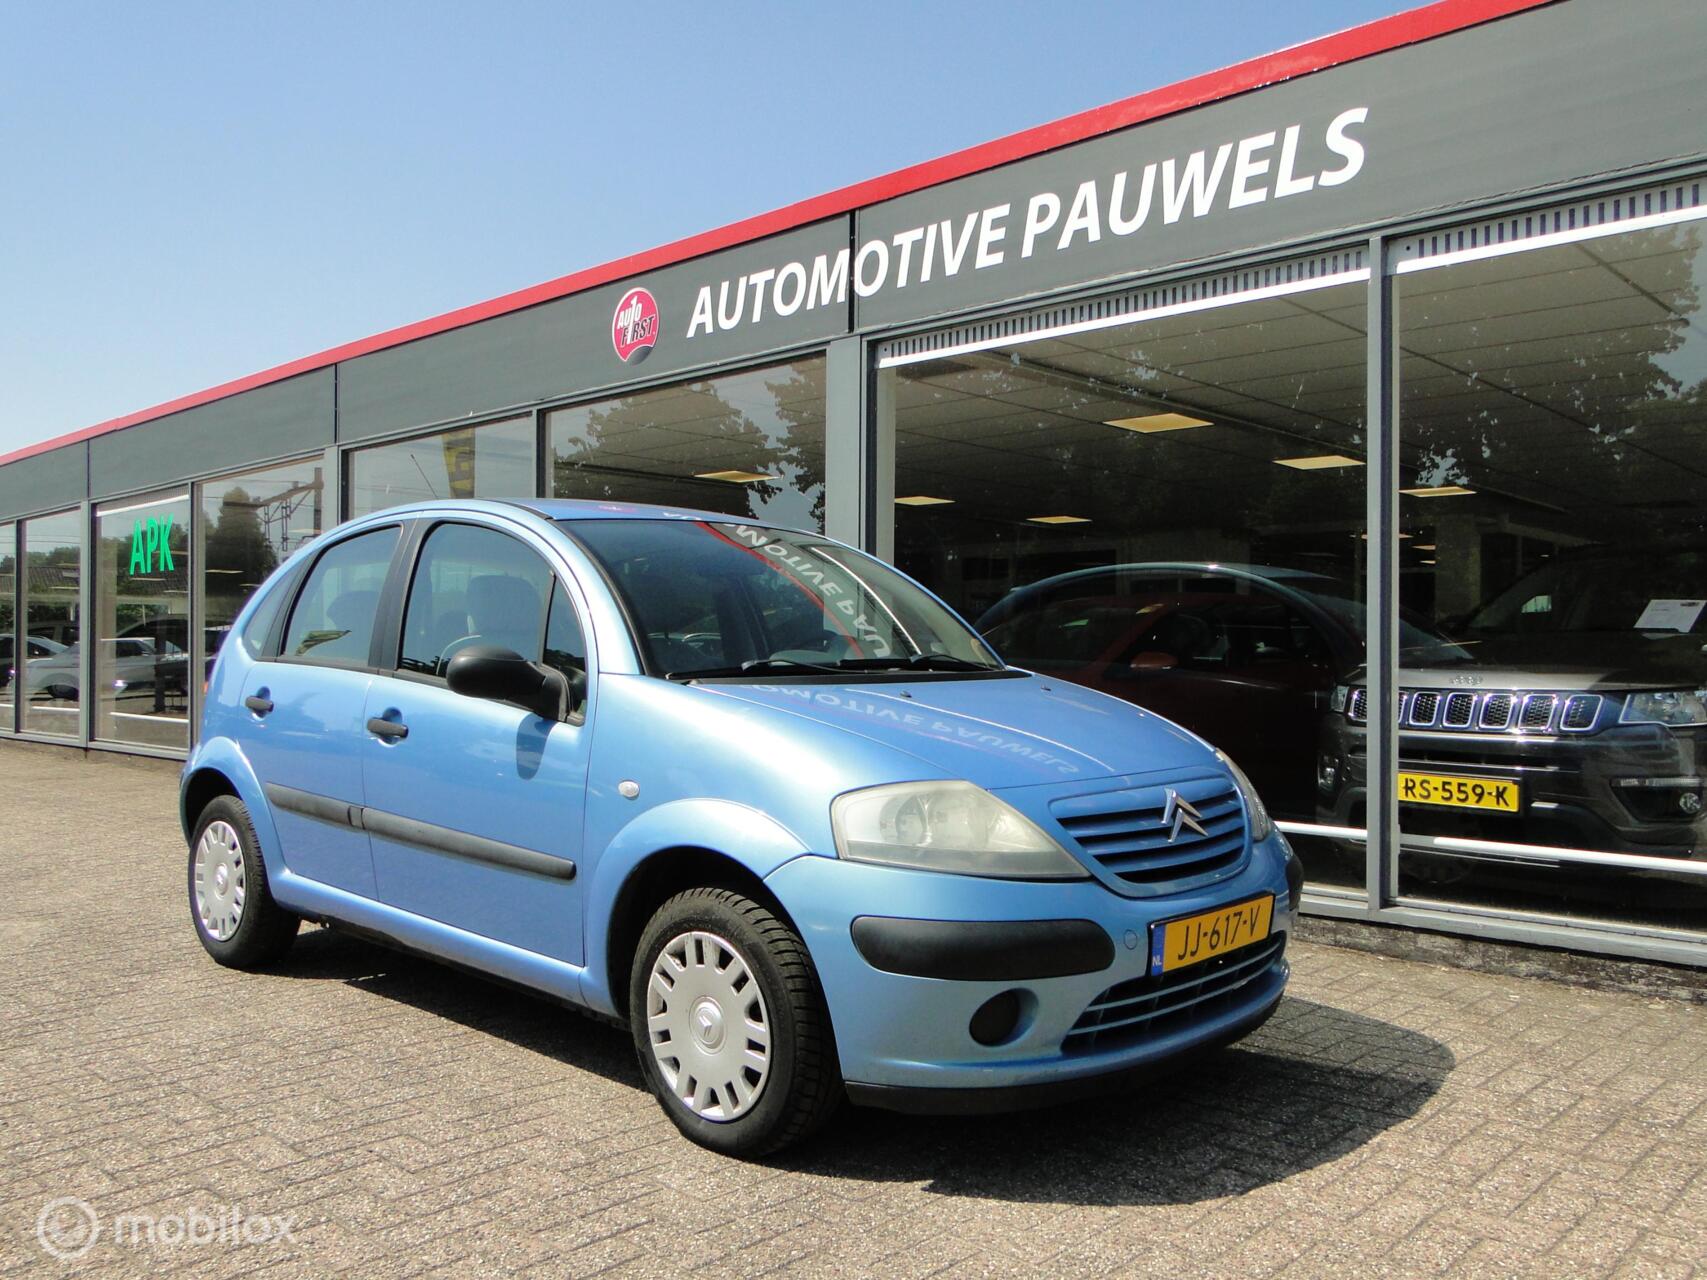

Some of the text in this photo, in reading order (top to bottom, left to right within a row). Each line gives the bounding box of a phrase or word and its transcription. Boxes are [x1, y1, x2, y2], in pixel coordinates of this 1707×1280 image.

[686, 107, 1369, 338] AUTOMOTIVE PAUWELS
[129, 513, 175, 575] APK
[1403, 777, 1509, 807] RS-559-K
[1178, 904, 1261, 961] JJ-617-V
[1152, 956, 1162, 967] NL
